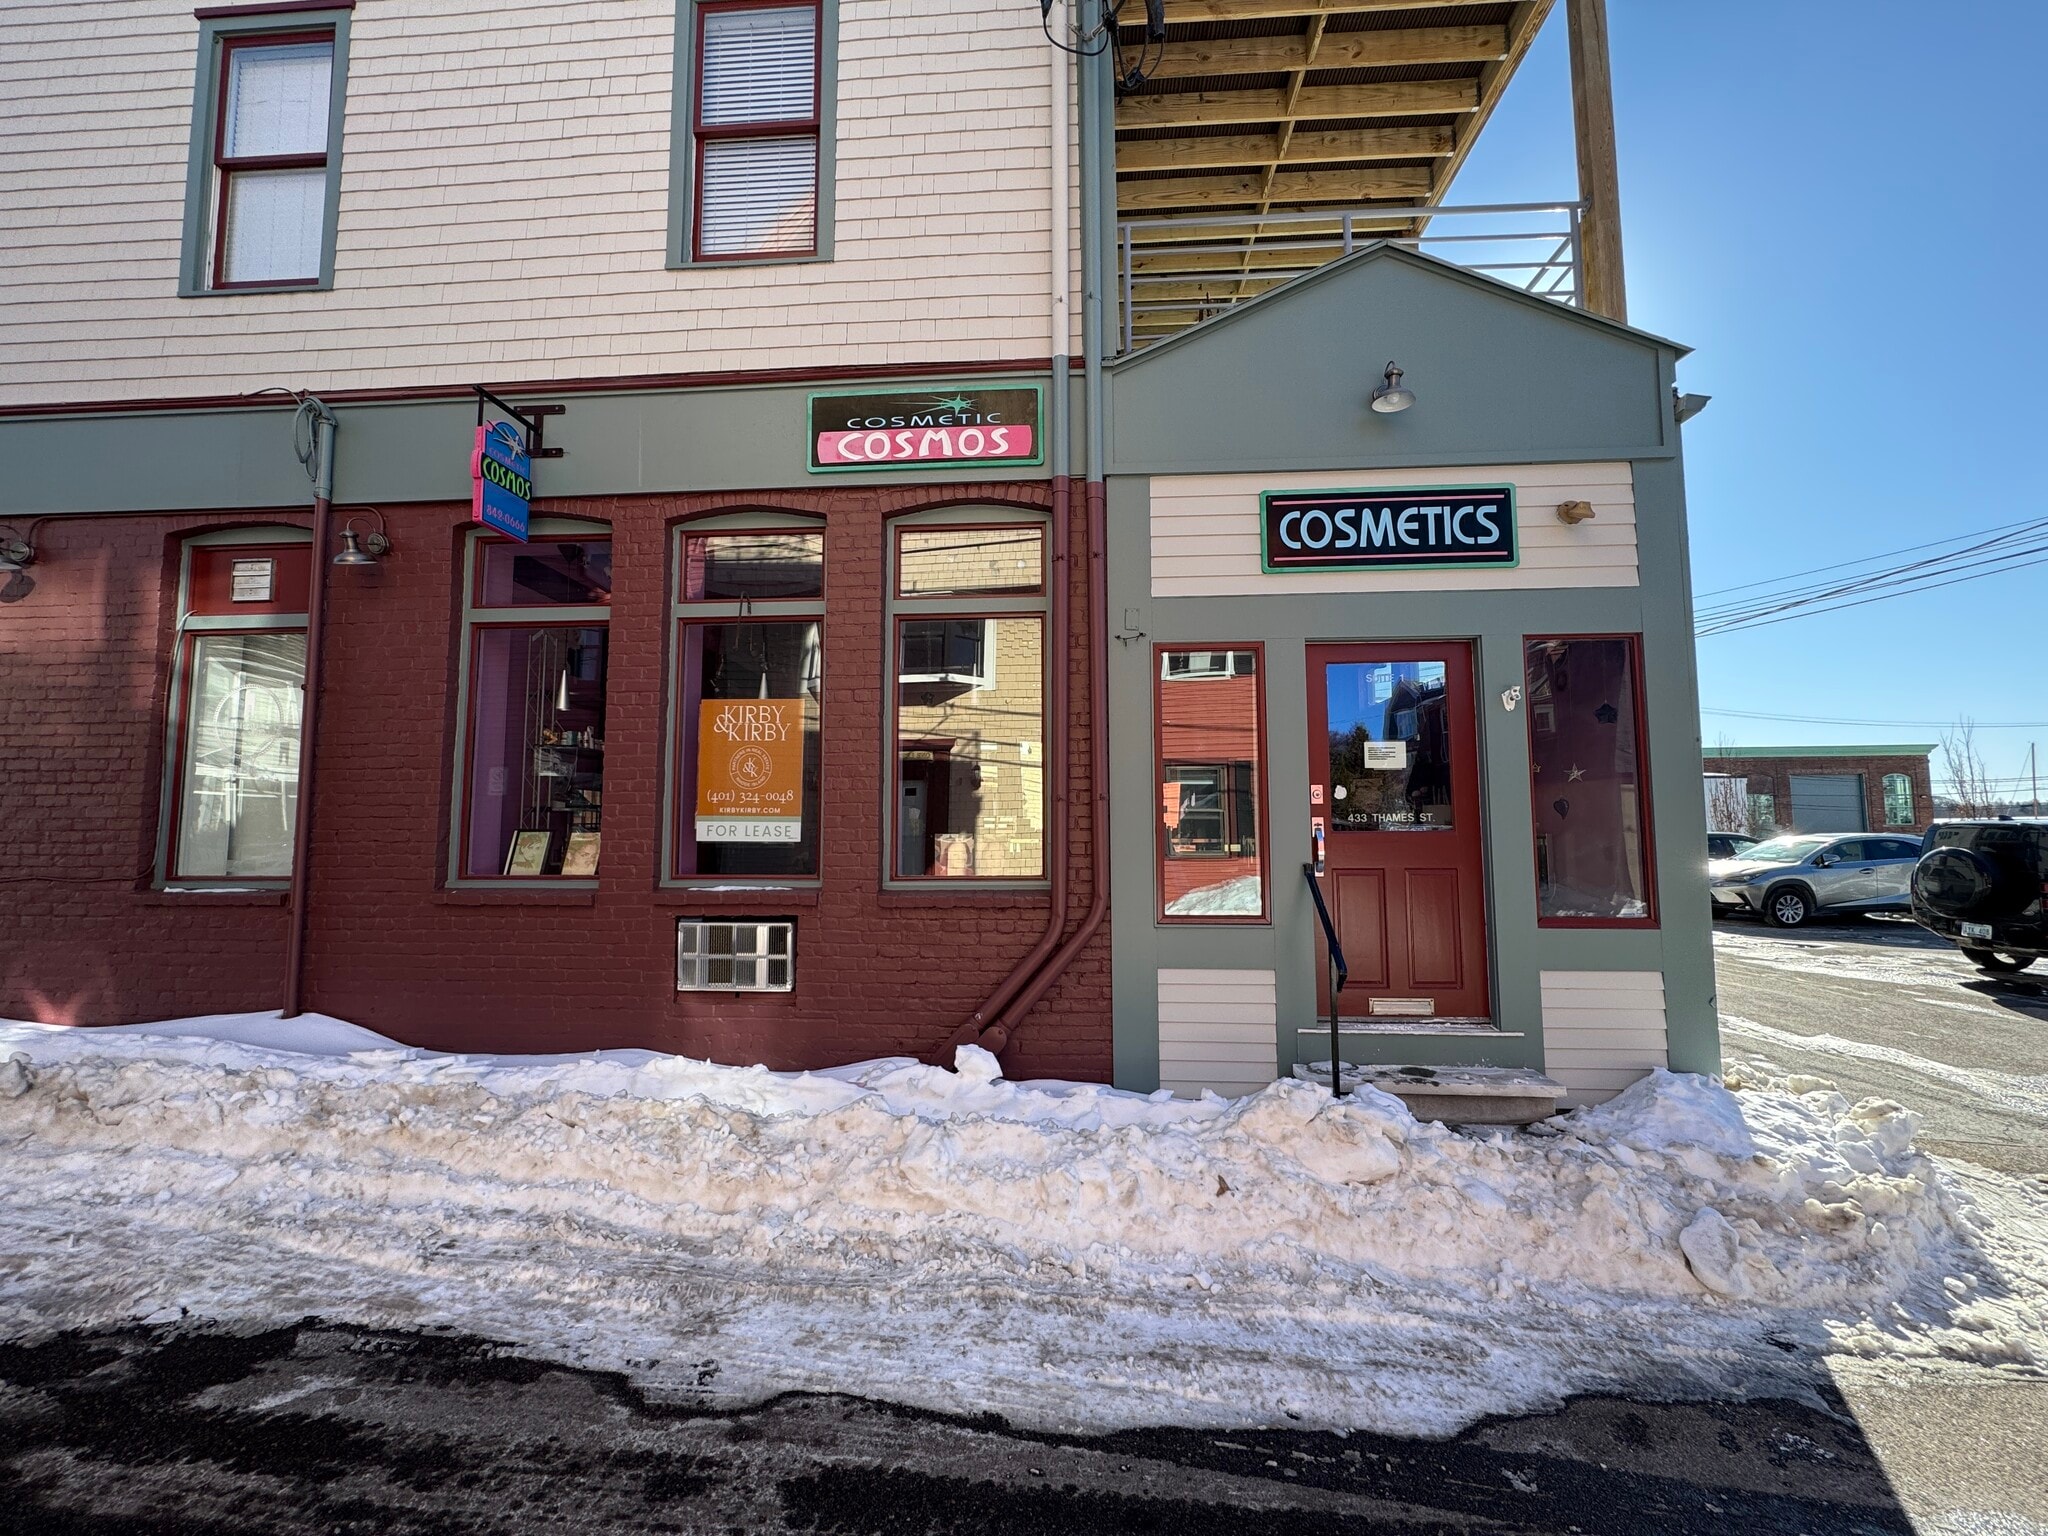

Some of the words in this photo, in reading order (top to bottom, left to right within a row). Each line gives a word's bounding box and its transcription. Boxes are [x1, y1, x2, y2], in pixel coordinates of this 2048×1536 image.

[846, 412, 1001, 429] COSMETIC
[837, 427, 1009, 461] COSMOS
[488, 447, 526, 473] COSMETIC
[483, 456, 532, 501] COSMOS
[1279, 505, 1500, 549] COSMETICS
[1365, 673, 1395, 683] SUITE
[724, 705, 787, 724] KIRBY
[728, 723, 792, 741] KIRBY
[706, 789, 735, 803] (401)
[739, 789, 794, 803] 324-0048
[1347, 814, 1367, 823] 433
[1372, 813, 1415, 823] THAMES
[1419, 813, 1436, 822] ST.
[706, 825, 737, 837] FOR
[744, 825, 792, 837] LEASE
